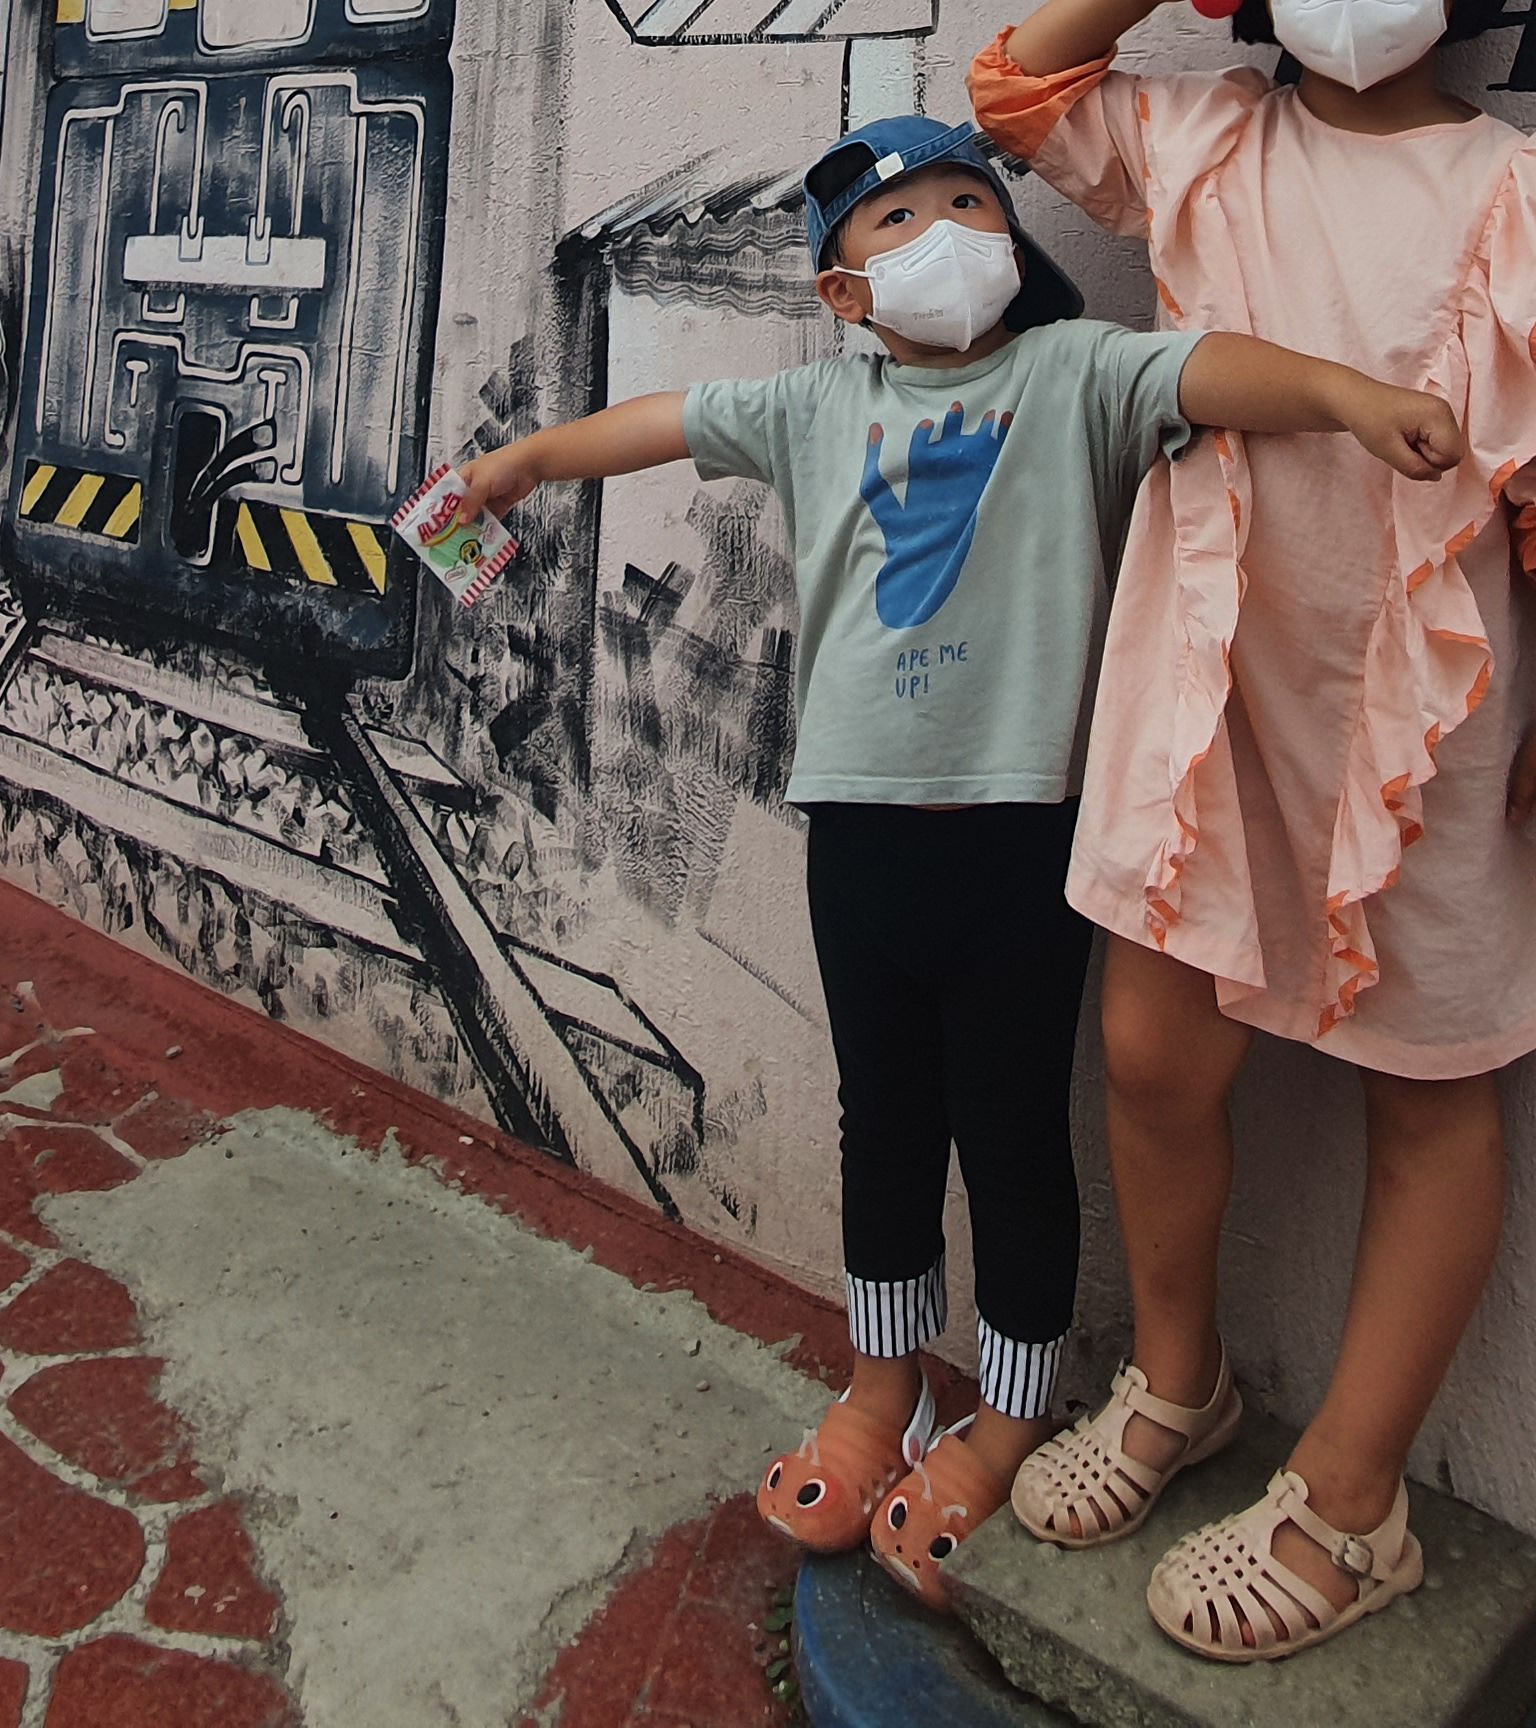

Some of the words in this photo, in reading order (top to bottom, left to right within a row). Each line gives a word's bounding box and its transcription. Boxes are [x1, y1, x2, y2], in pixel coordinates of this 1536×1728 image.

[896, 647, 930, 672] APE
[939, 641, 969, 665] ME
[895, 672, 929, 700] UP!
